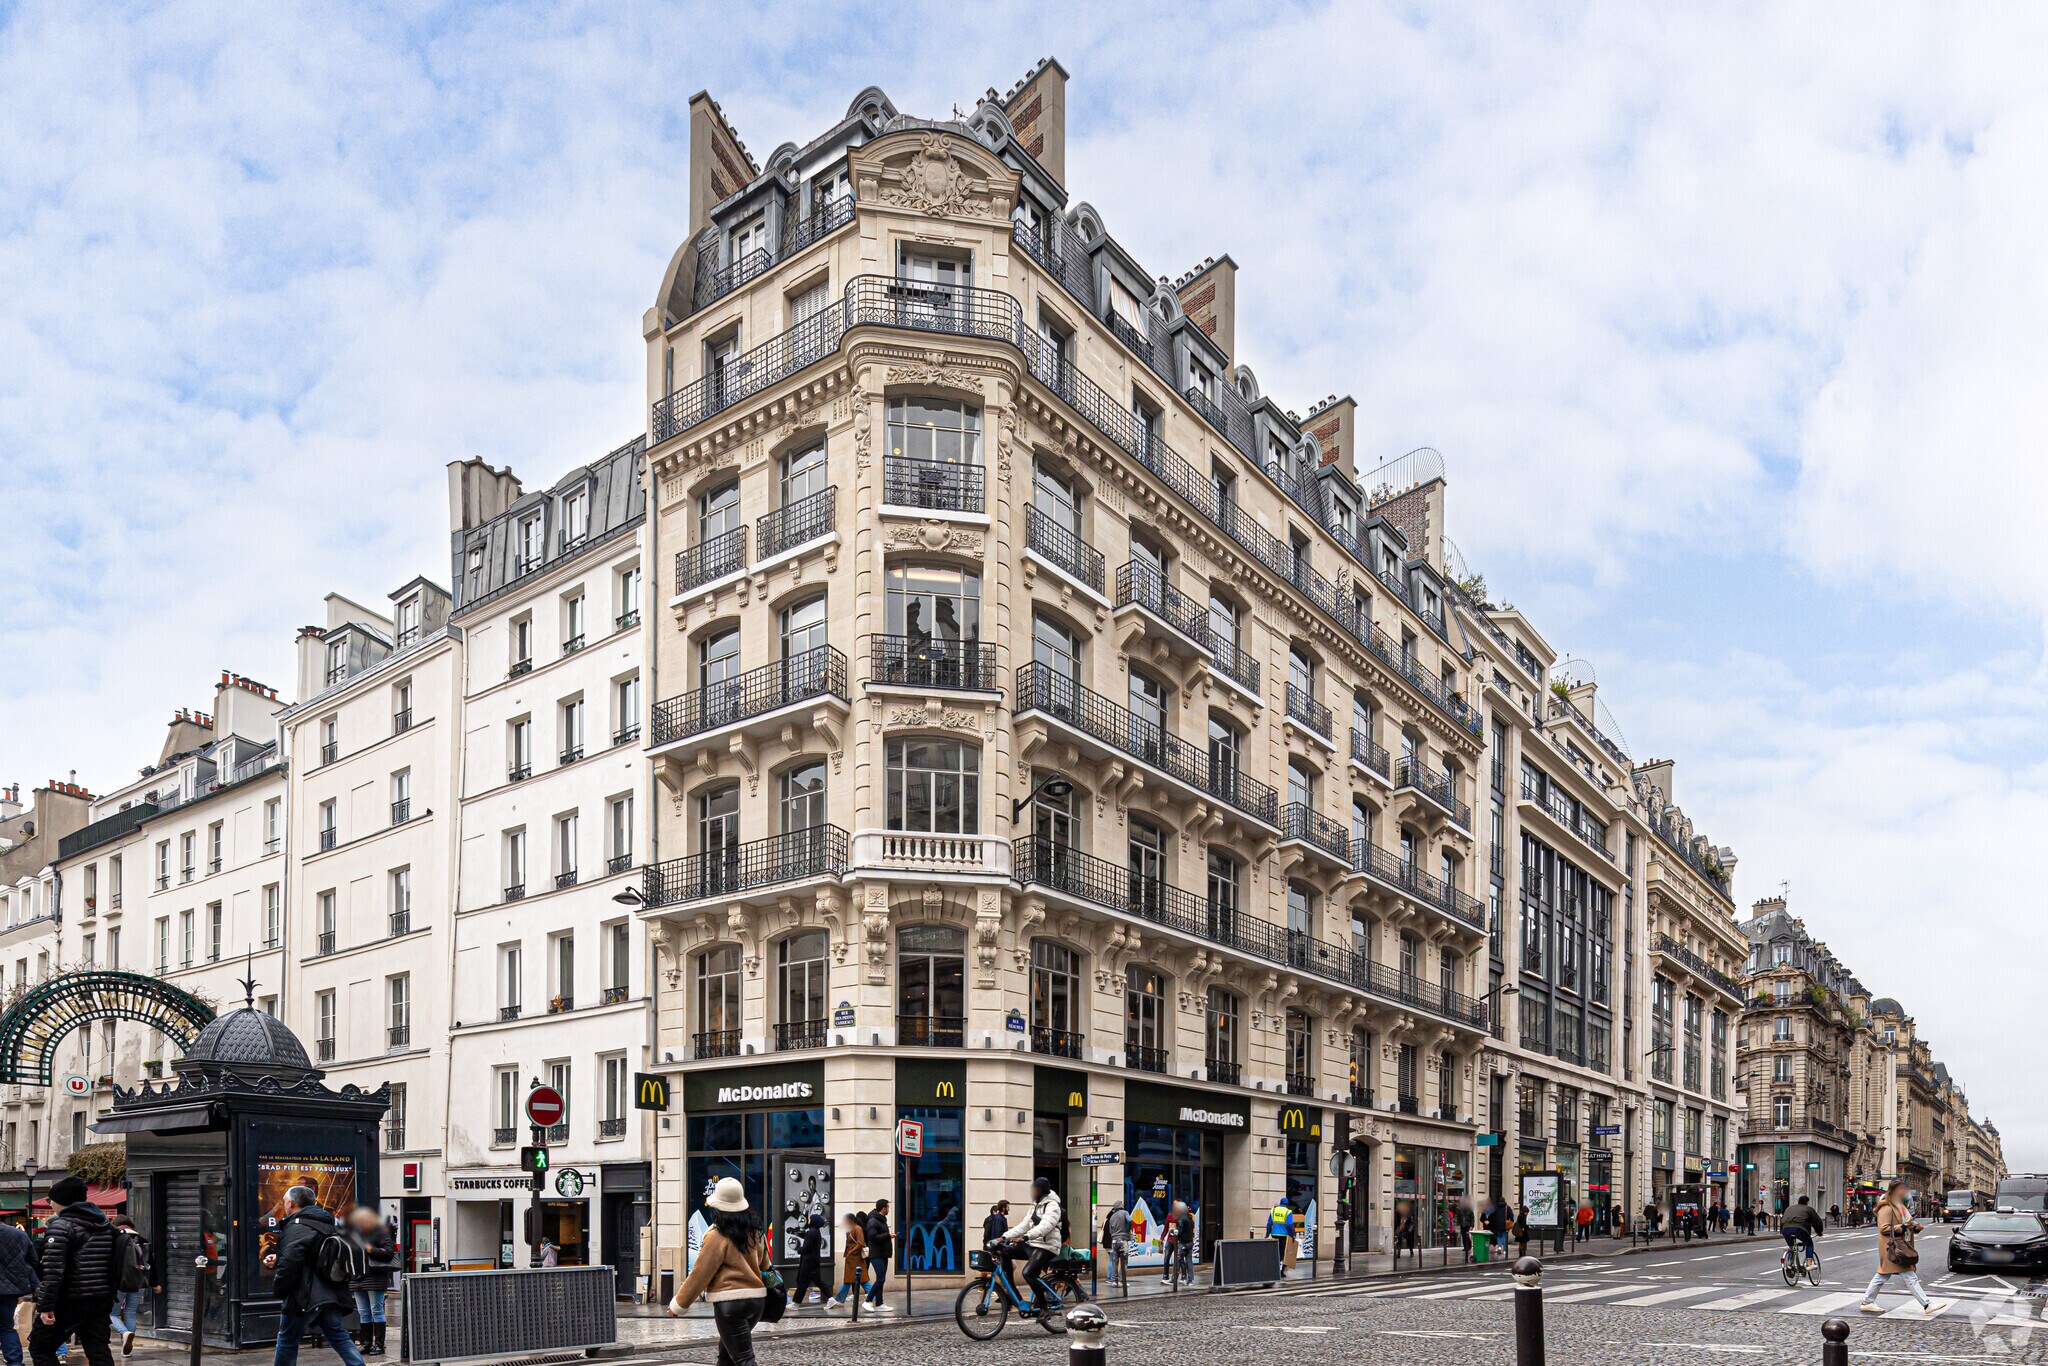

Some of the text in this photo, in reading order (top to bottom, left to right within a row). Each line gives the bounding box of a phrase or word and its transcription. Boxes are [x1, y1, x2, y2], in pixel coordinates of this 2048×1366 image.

[718, 1082, 812, 1103] McDonald's
[1180, 1108, 1244, 1127] McDonald's
[454, 1180, 502, 1190] STARBUCKS
